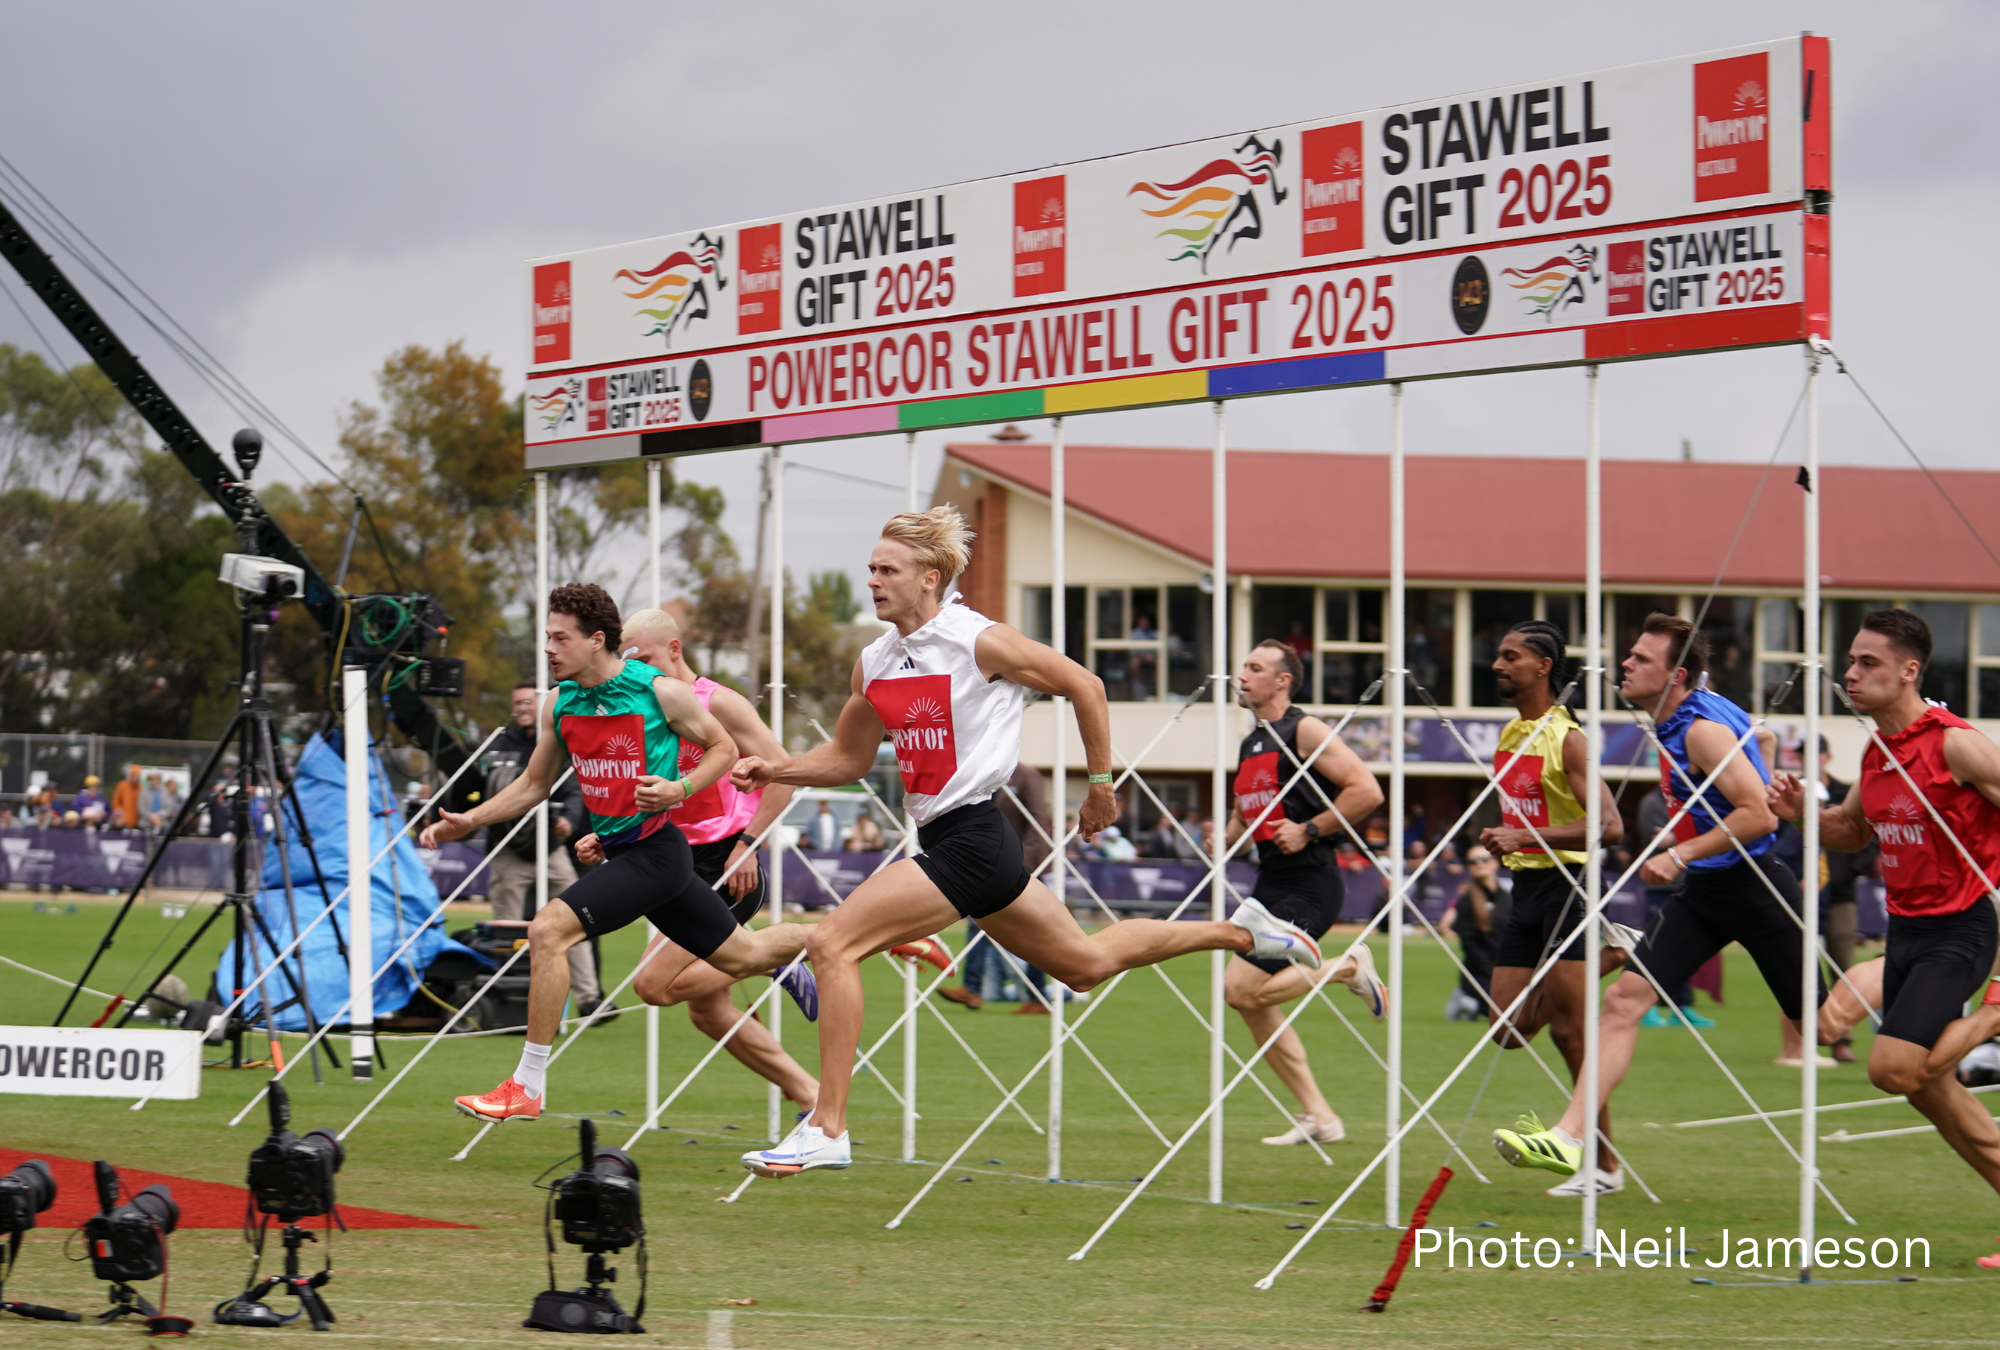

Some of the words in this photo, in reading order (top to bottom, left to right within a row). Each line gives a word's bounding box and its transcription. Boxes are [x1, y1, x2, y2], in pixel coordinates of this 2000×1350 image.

[1382, 80, 1610, 175] STAWELL
[1383, 174, 1486, 245] GIFT
[1497, 154, 1612, 228] 2025
[796, 194, 955, 268] STAWELL
[1648, 223, 1783, 273] STAWELL
[796, 269, 868, 327] GIFT
[874, 255, 956, 317] 2025
[1649, 273, 1709, 312] GIFT
[1717, 265, 1785, 305] 2025
[747, 330, 953, 412] POWERCOR
[967, 304, 1154, 387] STAWELL
[1169, 288, 1268, 364] GIFT
[1291, 274, 1396, 350] 2025
[608, 366, 682, 400] STAWELL
[608, 401, 641, 429] GIFT
[643, 398, 682, 426] 2025
[572, 752, 641, 779] Powercor
[0, 1043, 165, 1081] OWERCOR
